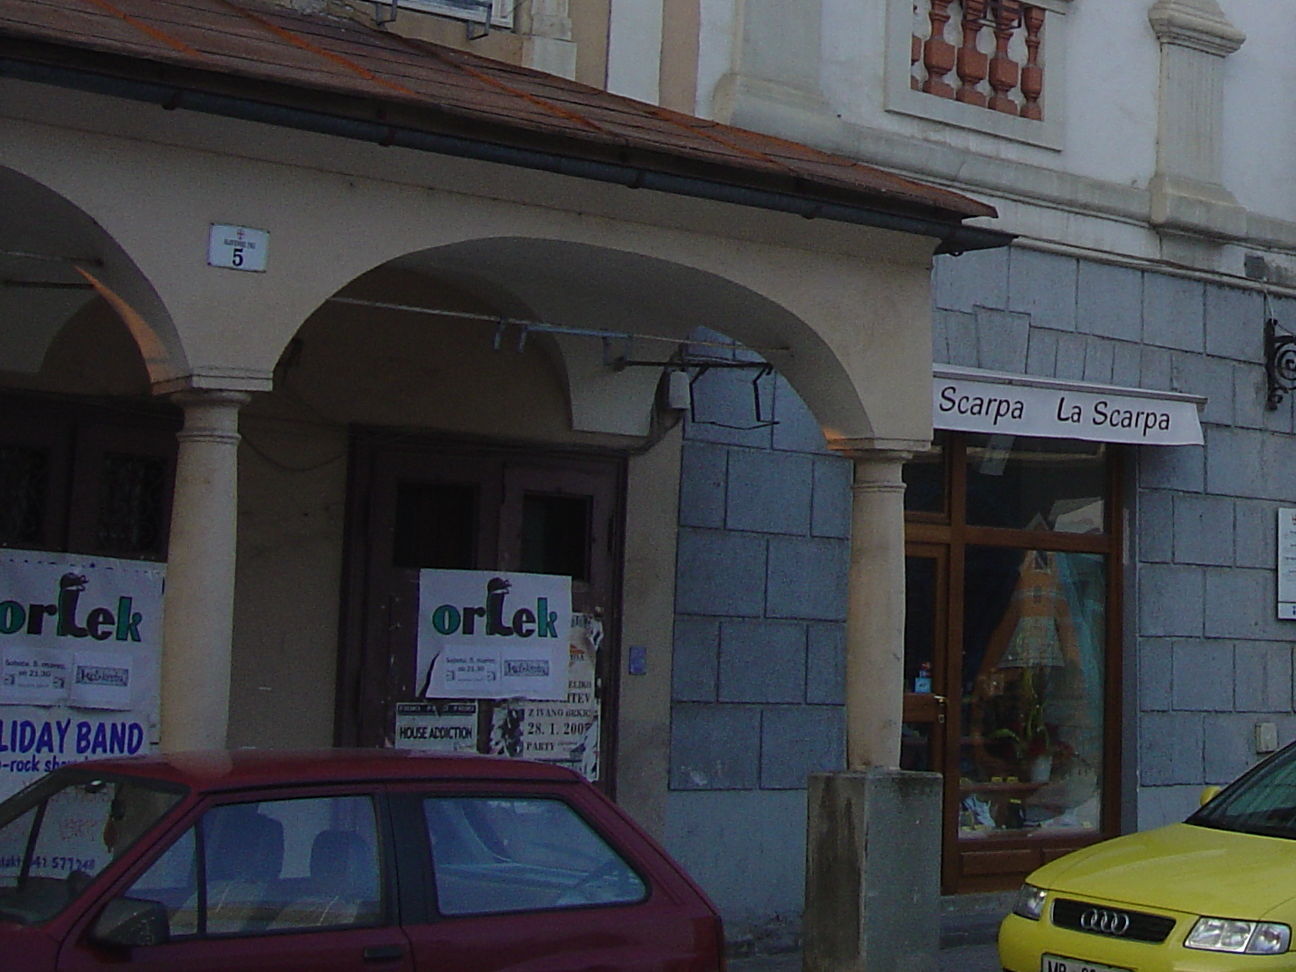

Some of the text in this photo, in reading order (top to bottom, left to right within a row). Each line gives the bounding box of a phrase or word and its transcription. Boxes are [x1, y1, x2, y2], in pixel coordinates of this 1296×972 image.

[232, 247, 244, 267] 5
[939, 386, 1171, 437] Scarpa La Scarpa
[76, 721, 144, 755] BAND
[399, 726, 473, 739] HOUSE ADDICTION
